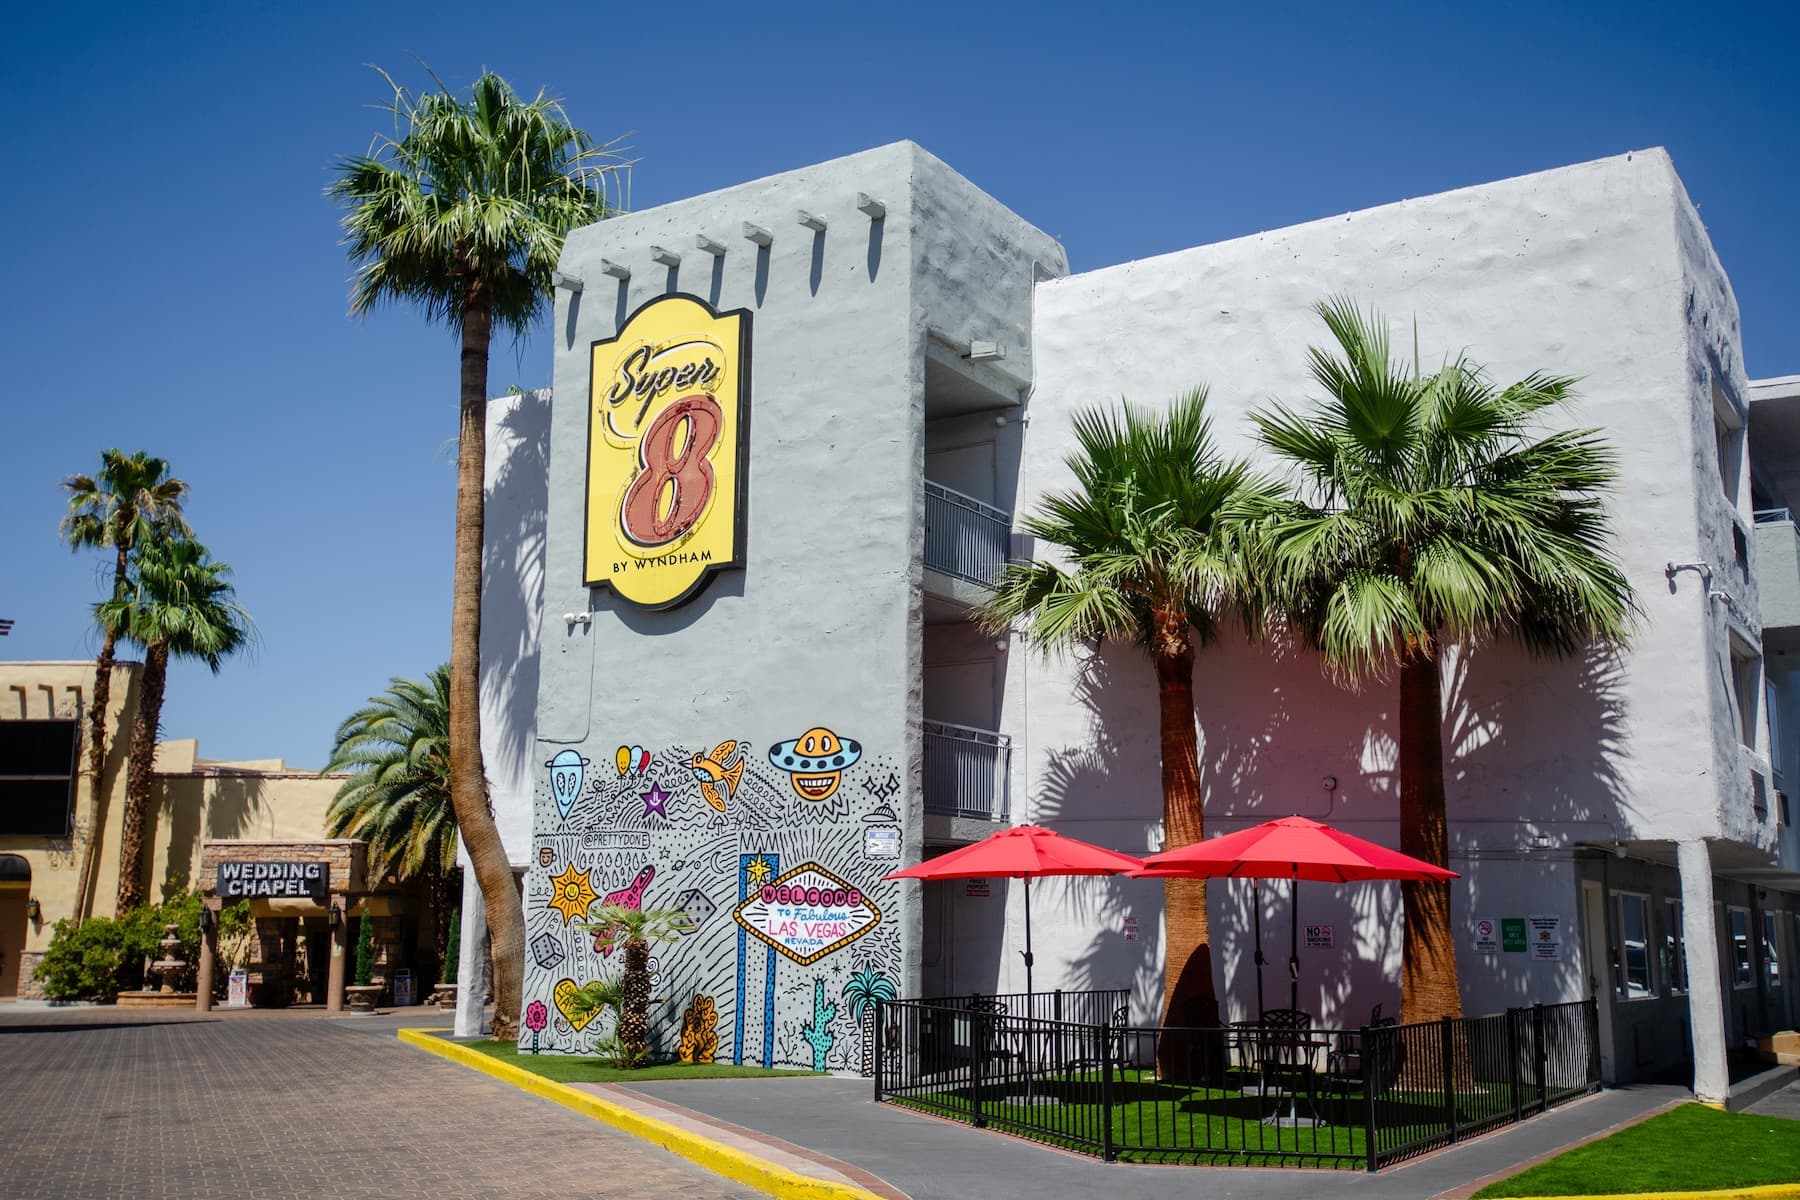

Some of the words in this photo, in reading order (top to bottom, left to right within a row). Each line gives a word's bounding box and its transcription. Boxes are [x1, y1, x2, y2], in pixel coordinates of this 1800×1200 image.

[609, 345, 720, 427] Super
[620, 394, 723, 547] 8
[613, 562, 628, 573] BY
[634, 550, 712, 570] WYNDHAM
[584, 834, 648, 847] @PRETTYDONE
[223, 864, 320, 879] WEDDING
[228, 880, 311, 895] CHAPEL
[763, 888, 859, 902] WELCOME
[777, 909, 790, 917] TO
[793, 908, 849, 921] Fabulous
[769, 920, 797, 937] LAS
[804, 922, 847, 938] VEGAS
[1306, 928, 1320, 937] NO
